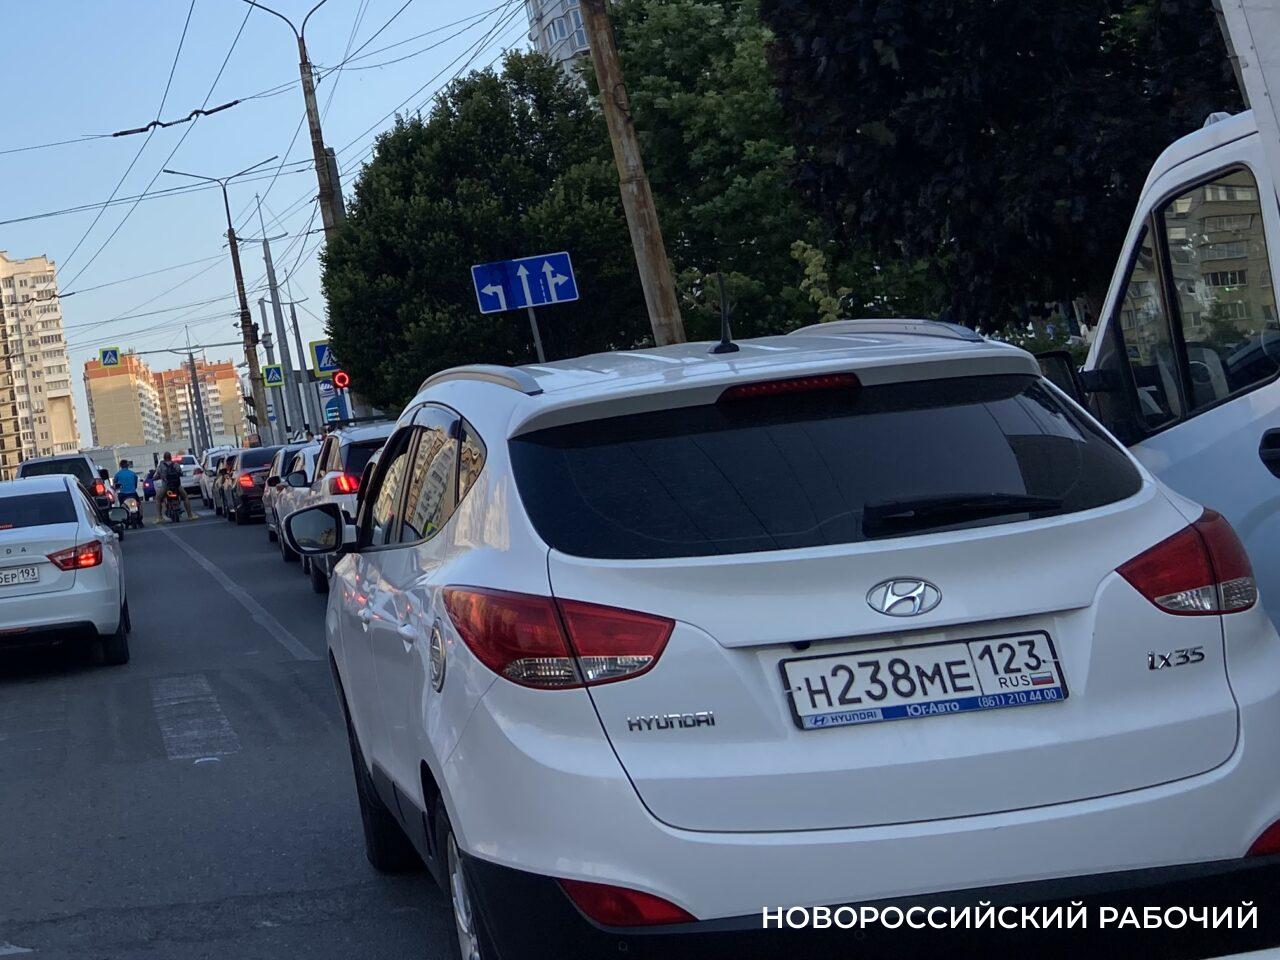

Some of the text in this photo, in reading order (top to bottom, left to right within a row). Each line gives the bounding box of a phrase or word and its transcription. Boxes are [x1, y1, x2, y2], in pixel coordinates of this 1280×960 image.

[20, 567, 36, 578] 193
[805, 640, 1042, 709] Н238МЕ 123
[998, 674, 1031, 689] RUS
[978, 688, 1057, 708] (861) 210 44 00
[627, 711, 716, 732] HYUNDAI
[831, 711, 877, 724] HYUNDAI
